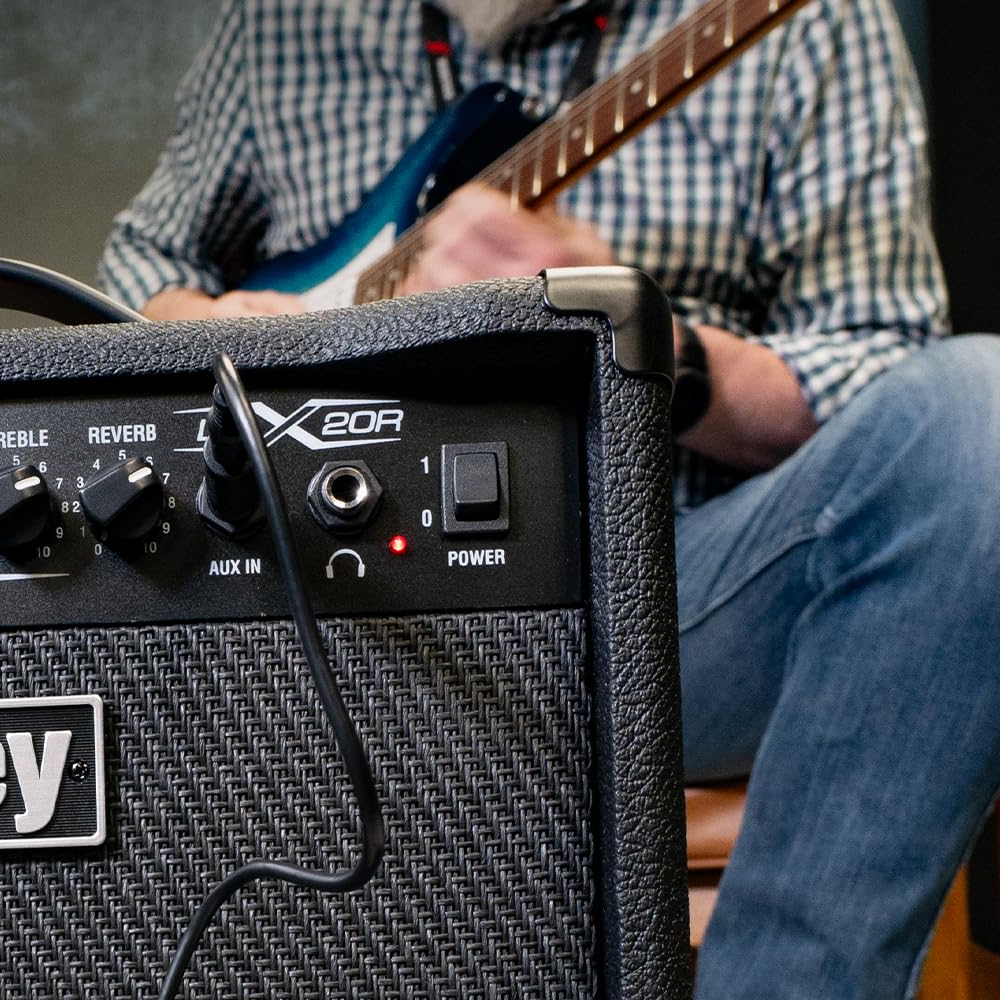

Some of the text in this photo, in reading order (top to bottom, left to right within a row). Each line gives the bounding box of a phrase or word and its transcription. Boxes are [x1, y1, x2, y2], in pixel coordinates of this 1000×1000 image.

[321, 409, 404, 436] 20R
[88, 424, 156, 444] REVERB
[13, 455, 20, 466] 5
[119, 450, 126, 460] 5
[39, 462, 47, 473] 6
[93, 459, 100, 470] 4
[420, 456, 430, 474] 1
[56, 478, 63, 490] 7
[77, 477, 84, 488] 3
[162, 473, 170, 484] 7
[62, 502, 68, 512] 8
[72, 502, 80, 512] 2
[168, 496, 175, 508] 8
[56, 527, 63, 538] 9
[163, 522, 170, 534] 9
[94, 544, 102, 555] 0
[447, 549, 506, 566] POWER
[209, 558, 261, 576] AUX IN
